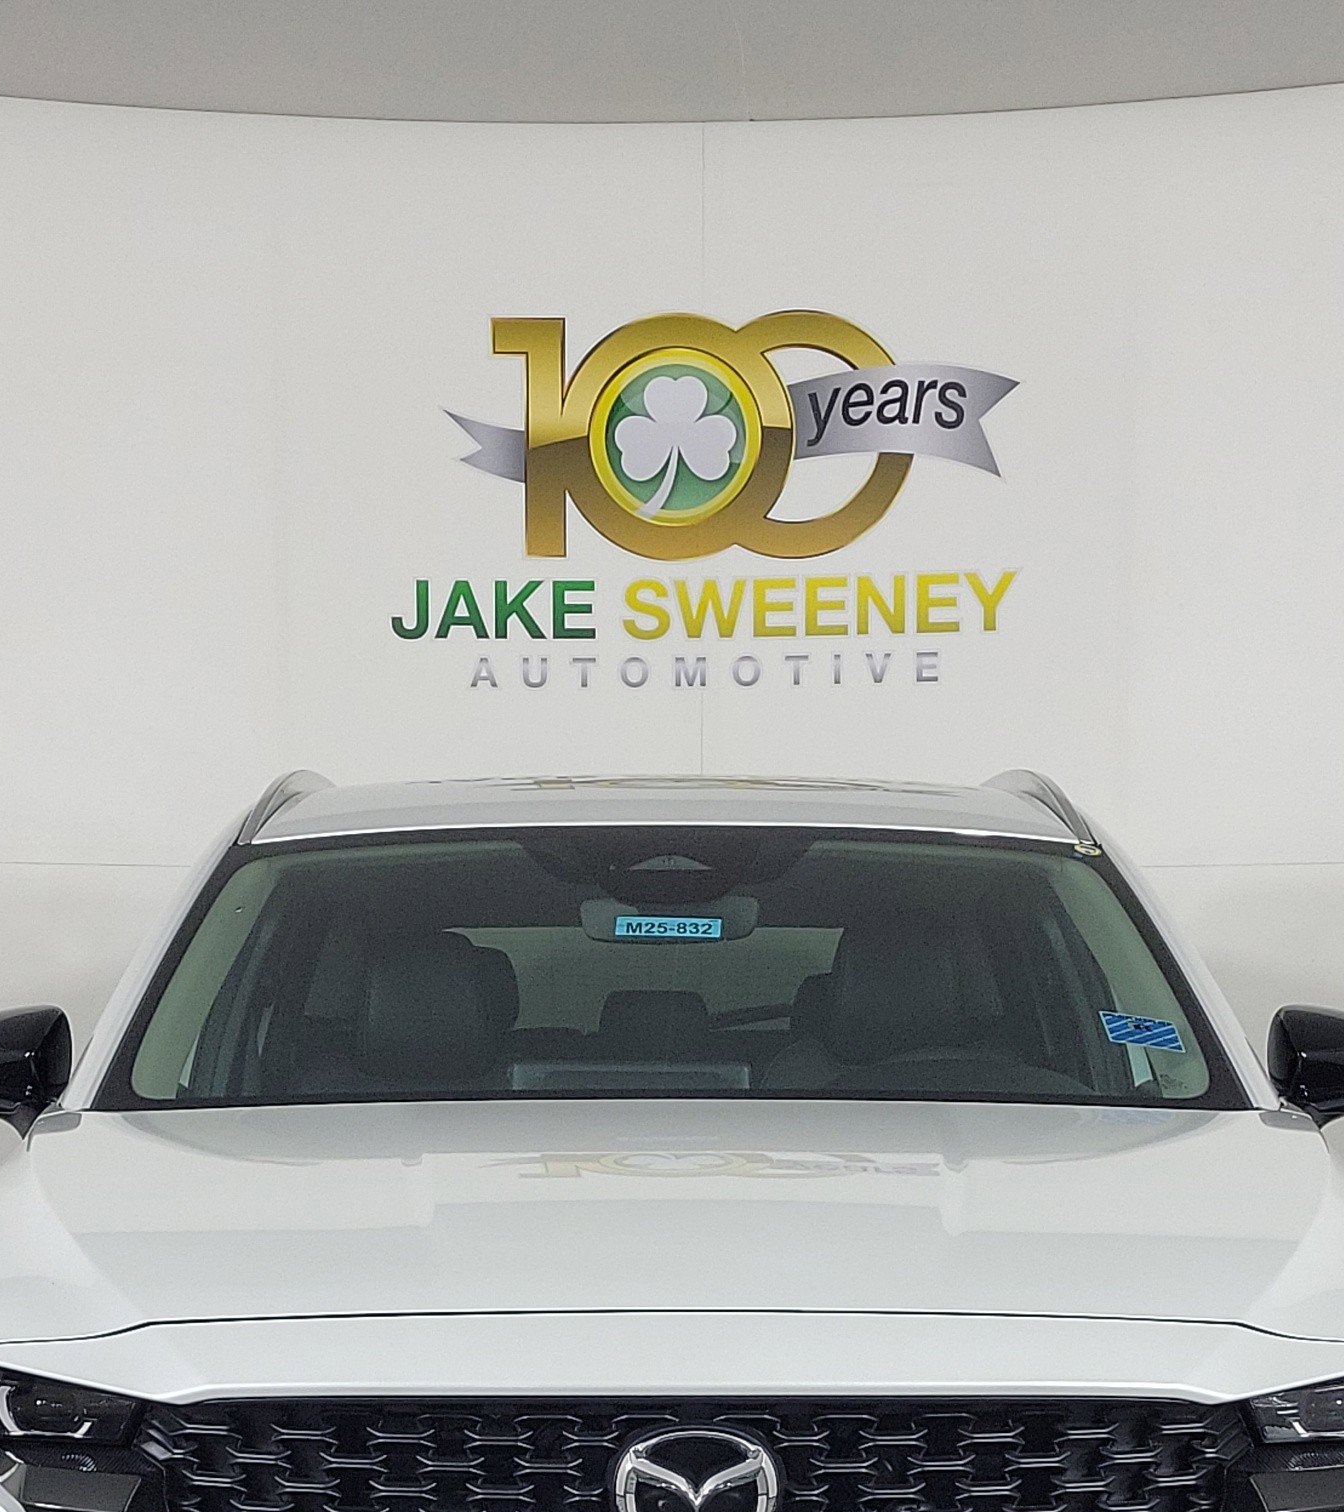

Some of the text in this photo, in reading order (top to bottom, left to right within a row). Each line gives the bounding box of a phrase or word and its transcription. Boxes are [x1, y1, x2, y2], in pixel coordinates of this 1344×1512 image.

[491, 309, 967, 560] 100 years
[391, 570, 1017, 640] JAKE SWEENEY
[469, 651, 940, 689] AUTOMOTIVE
[625, 922, 713, 935] M25-832
